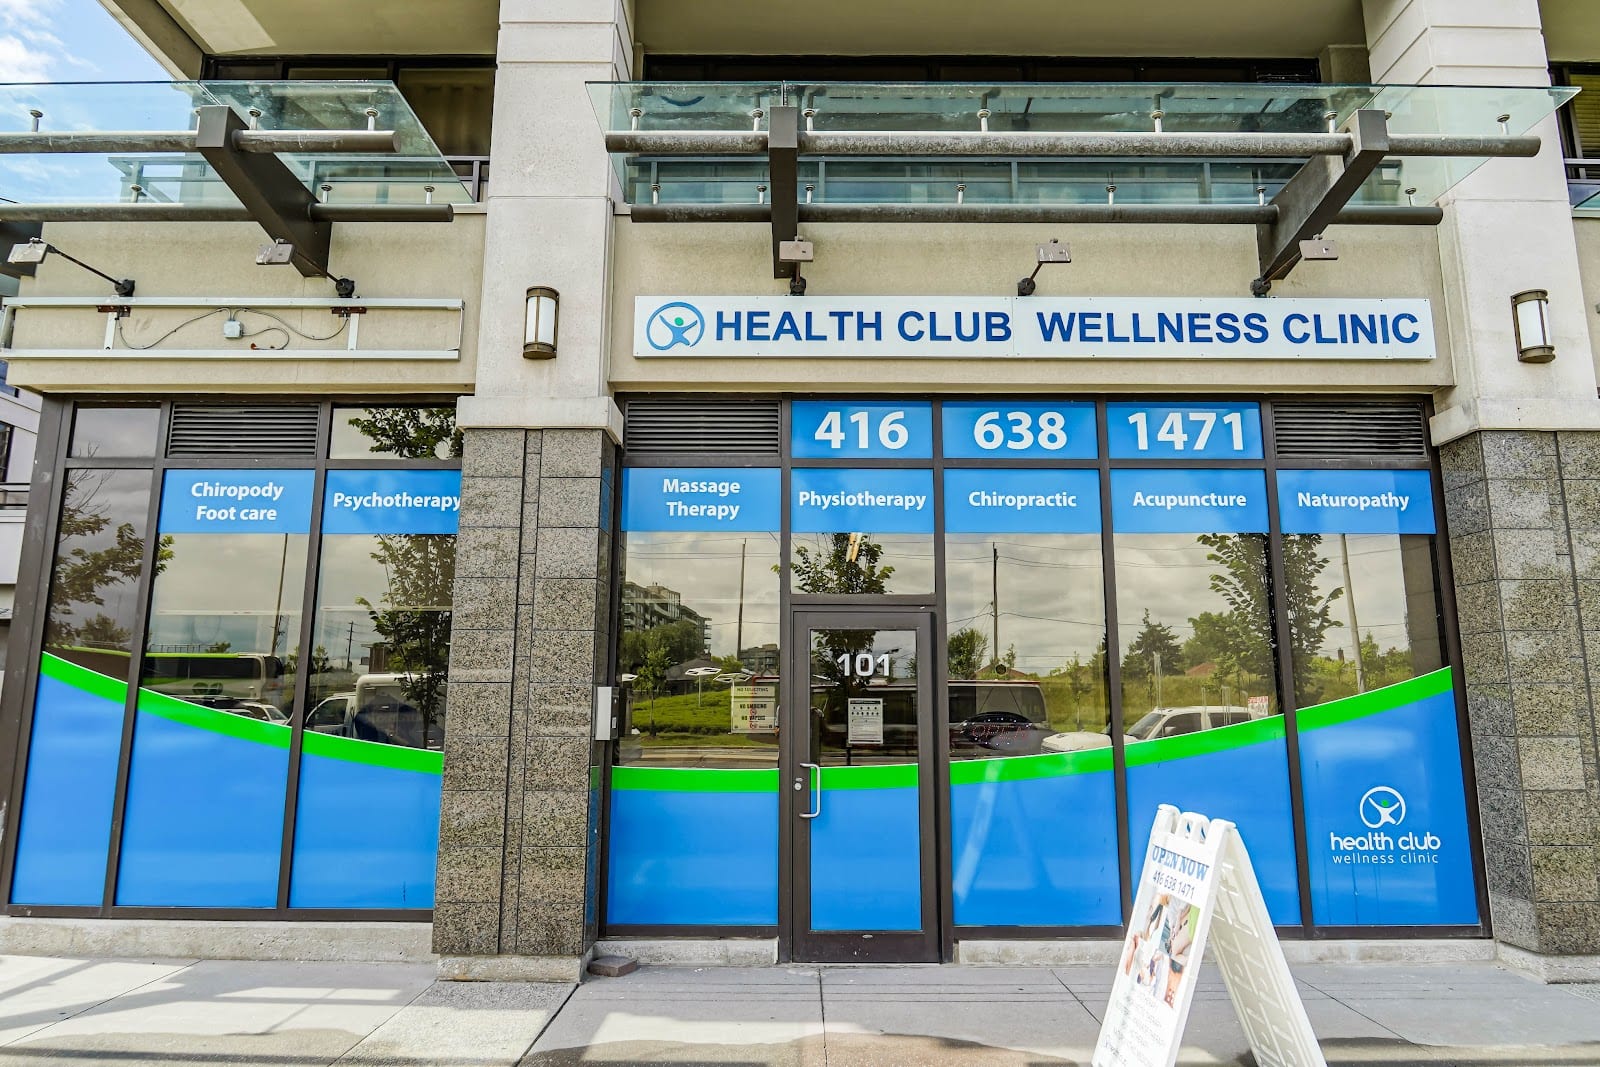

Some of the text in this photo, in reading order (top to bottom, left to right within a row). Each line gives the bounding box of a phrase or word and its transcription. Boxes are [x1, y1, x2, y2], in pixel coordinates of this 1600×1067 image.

[715, 310, 1420, 345] HEALTH CLUB WELLNESS CLINIC
[814, 411, 1243, 450] 416 638 1471
[191, 481, 284, 501] Chiropody
[663, 478, 741, 497] Massage
[333, 491, 461, 512] Psychotherapy
[799, 490, 927, 511] Physiotherapy
[968, 491, 1077, 510] Chiropractic
[1133, 491, 1247, 510] Acupuncture
[1297, 492, 1409, 512] Naturopathy
[196, 505, 278, 521] Foot care
[666, 501, 740, 521] Therapy
[837, 653, 890, 677] 101
[1329, 831, 1442, 851] health club
[1151, 845, 1210, 881] OPEN NOW
[1332, 852, 1439, 864] wellness clinic
[1152, 870, 1196, 900] 416 638 1471
